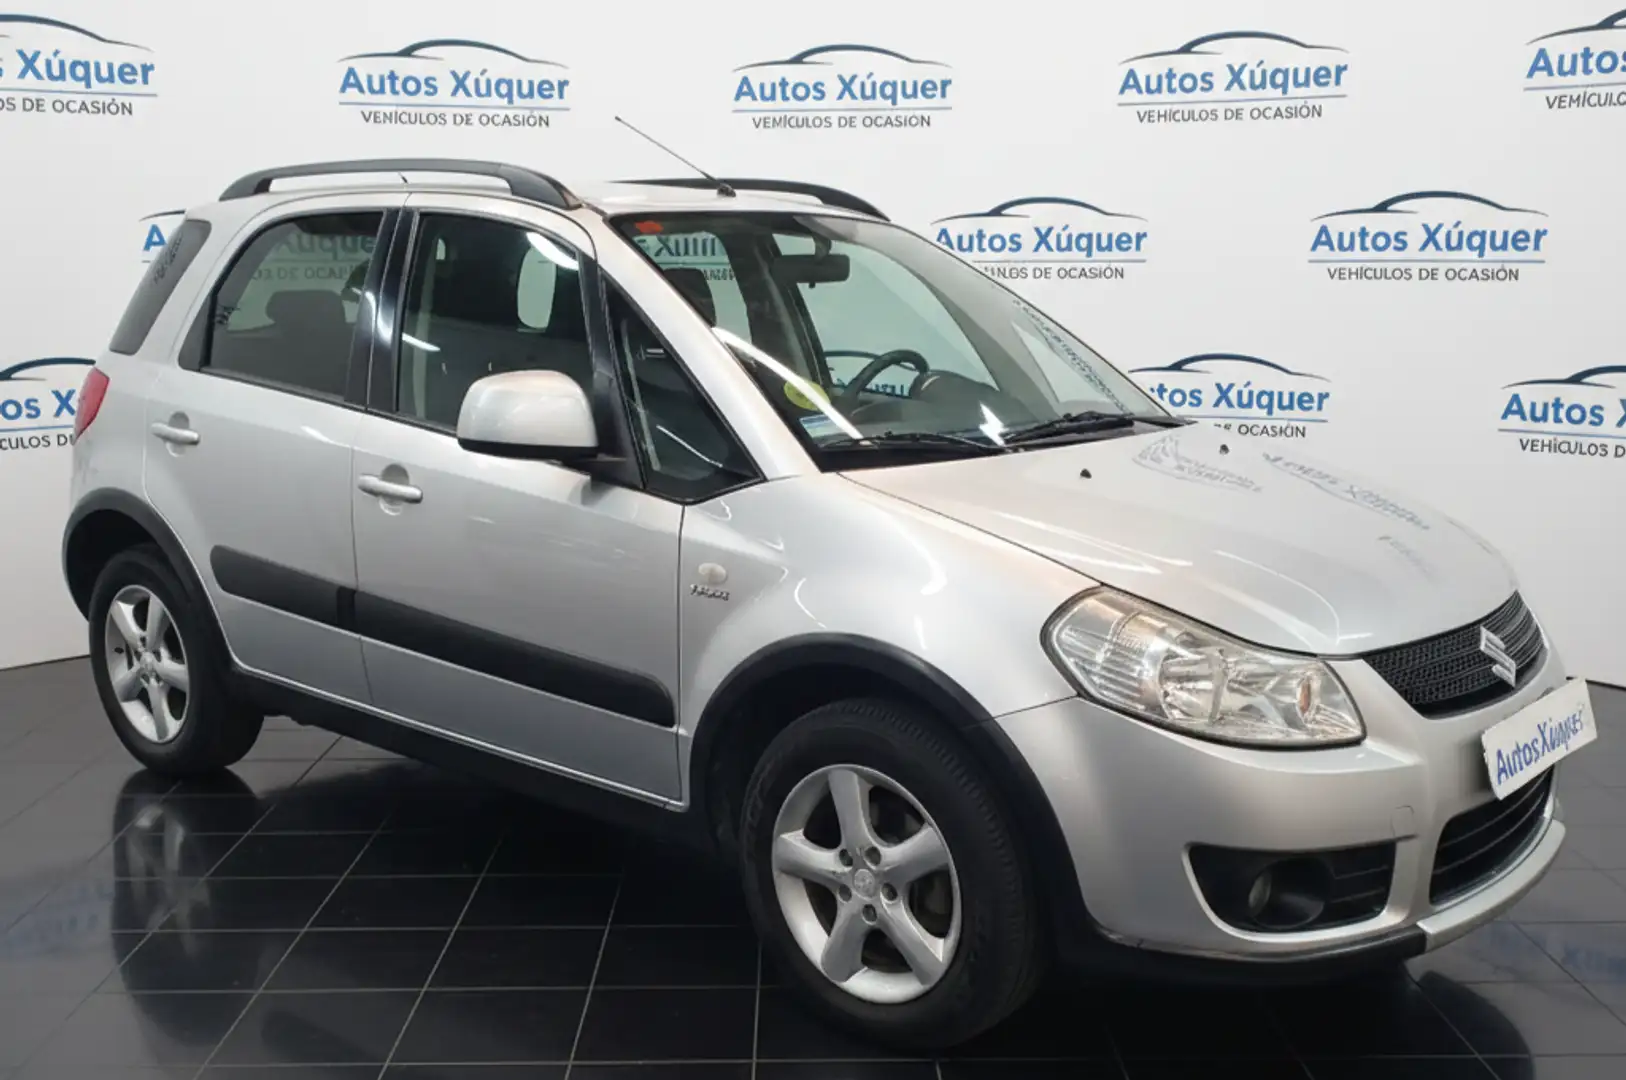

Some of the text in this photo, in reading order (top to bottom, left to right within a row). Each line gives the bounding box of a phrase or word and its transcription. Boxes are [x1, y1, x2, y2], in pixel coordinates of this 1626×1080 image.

[16, 49, 155, 89] Xúquer
[1118, 59, 1348, 96] Autos Xúquer
[339, 66, 570, 105] Autos Xúquer
[734, 72, 952, 106] Autos Xúquer
[22, 97, 46, 112] DE
[52, 98, 133, 116] OCASIÓN
[453, 113, 473, 127] DE
[478, 110, 550, 128] OCASIÓN
[838, 115, 857, 128] DE
[862, 112, 931, 128] OCASIÓN
[1136, 101, 1323, 124] VEHÍCULOS DE OCASIÓN
[936, 224, 1148, 258] Autos Xúquer
[1310, 220, 1548, 259] Autos Xúquer
[1033, 267, 1052, 279] DE
[1057, 264, 1125, 280] OCASIÓN
[1327, 264, 1520, 282] VEHÍCULOS DE OCASIÓN
[0, 397, 42, 421] os
[1150, 380, 1330, 416] tos Xúquer
[1501, 393, 1605, 427] Autos
[1519, 437, 1609, 457] VEHÍCULOS
